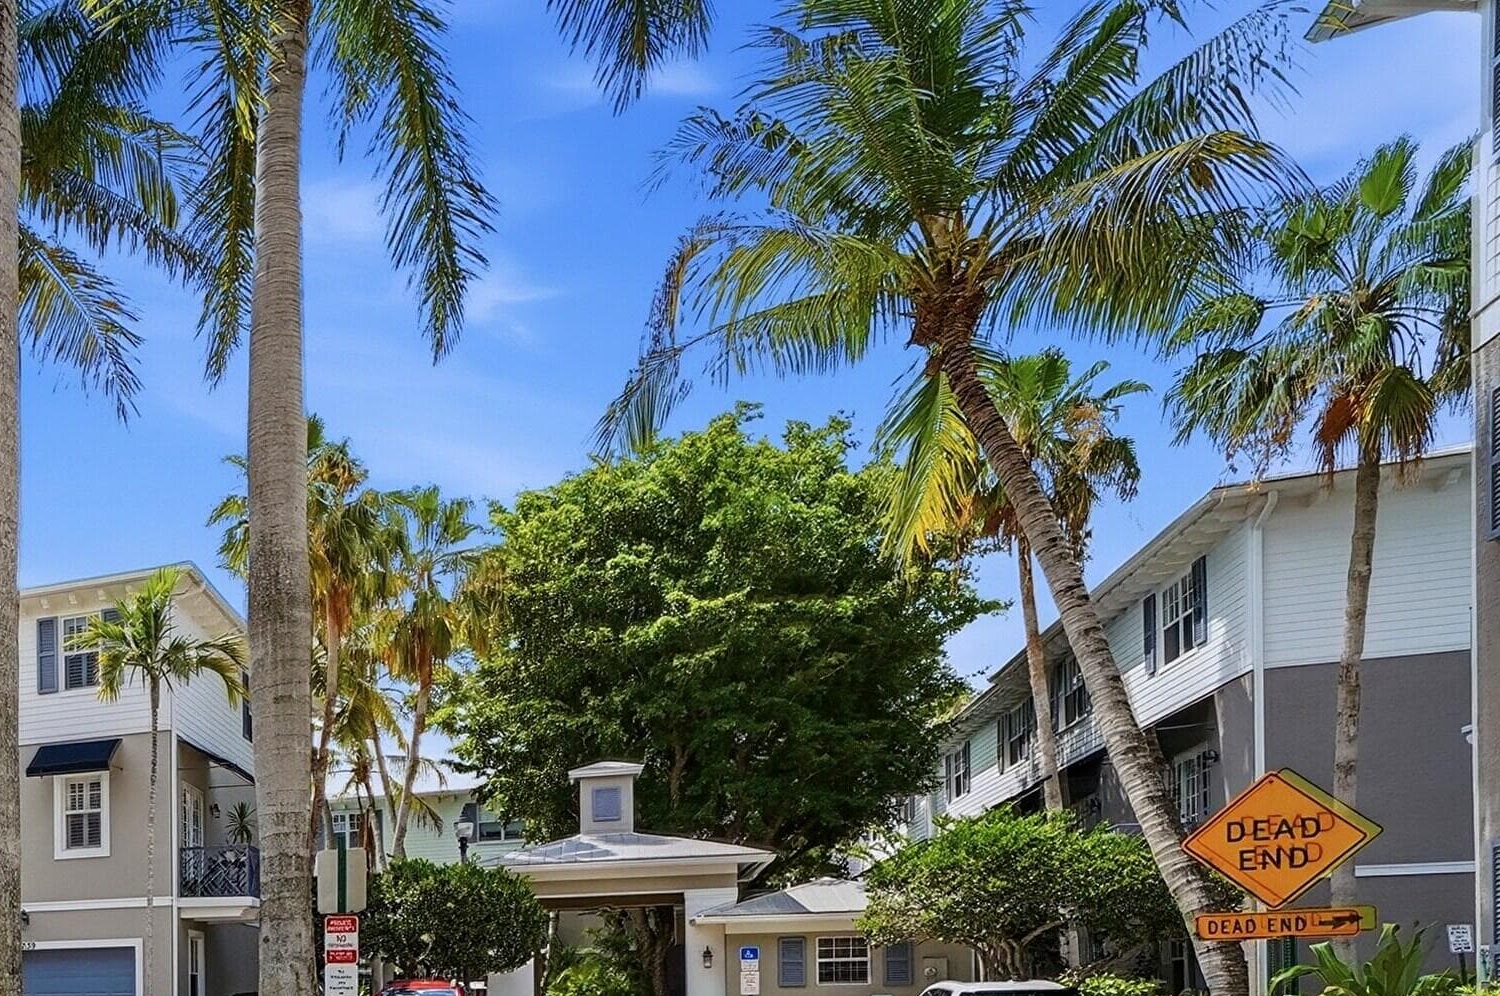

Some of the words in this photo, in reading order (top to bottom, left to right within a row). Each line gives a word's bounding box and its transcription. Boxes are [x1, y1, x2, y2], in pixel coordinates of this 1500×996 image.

[1226, 817, 1322, 843] DEAD
[1238, 847, 1310, 871] END
[1208, 919, 1256, 935] DEAD
[1267, 916, 1308, 932] END
